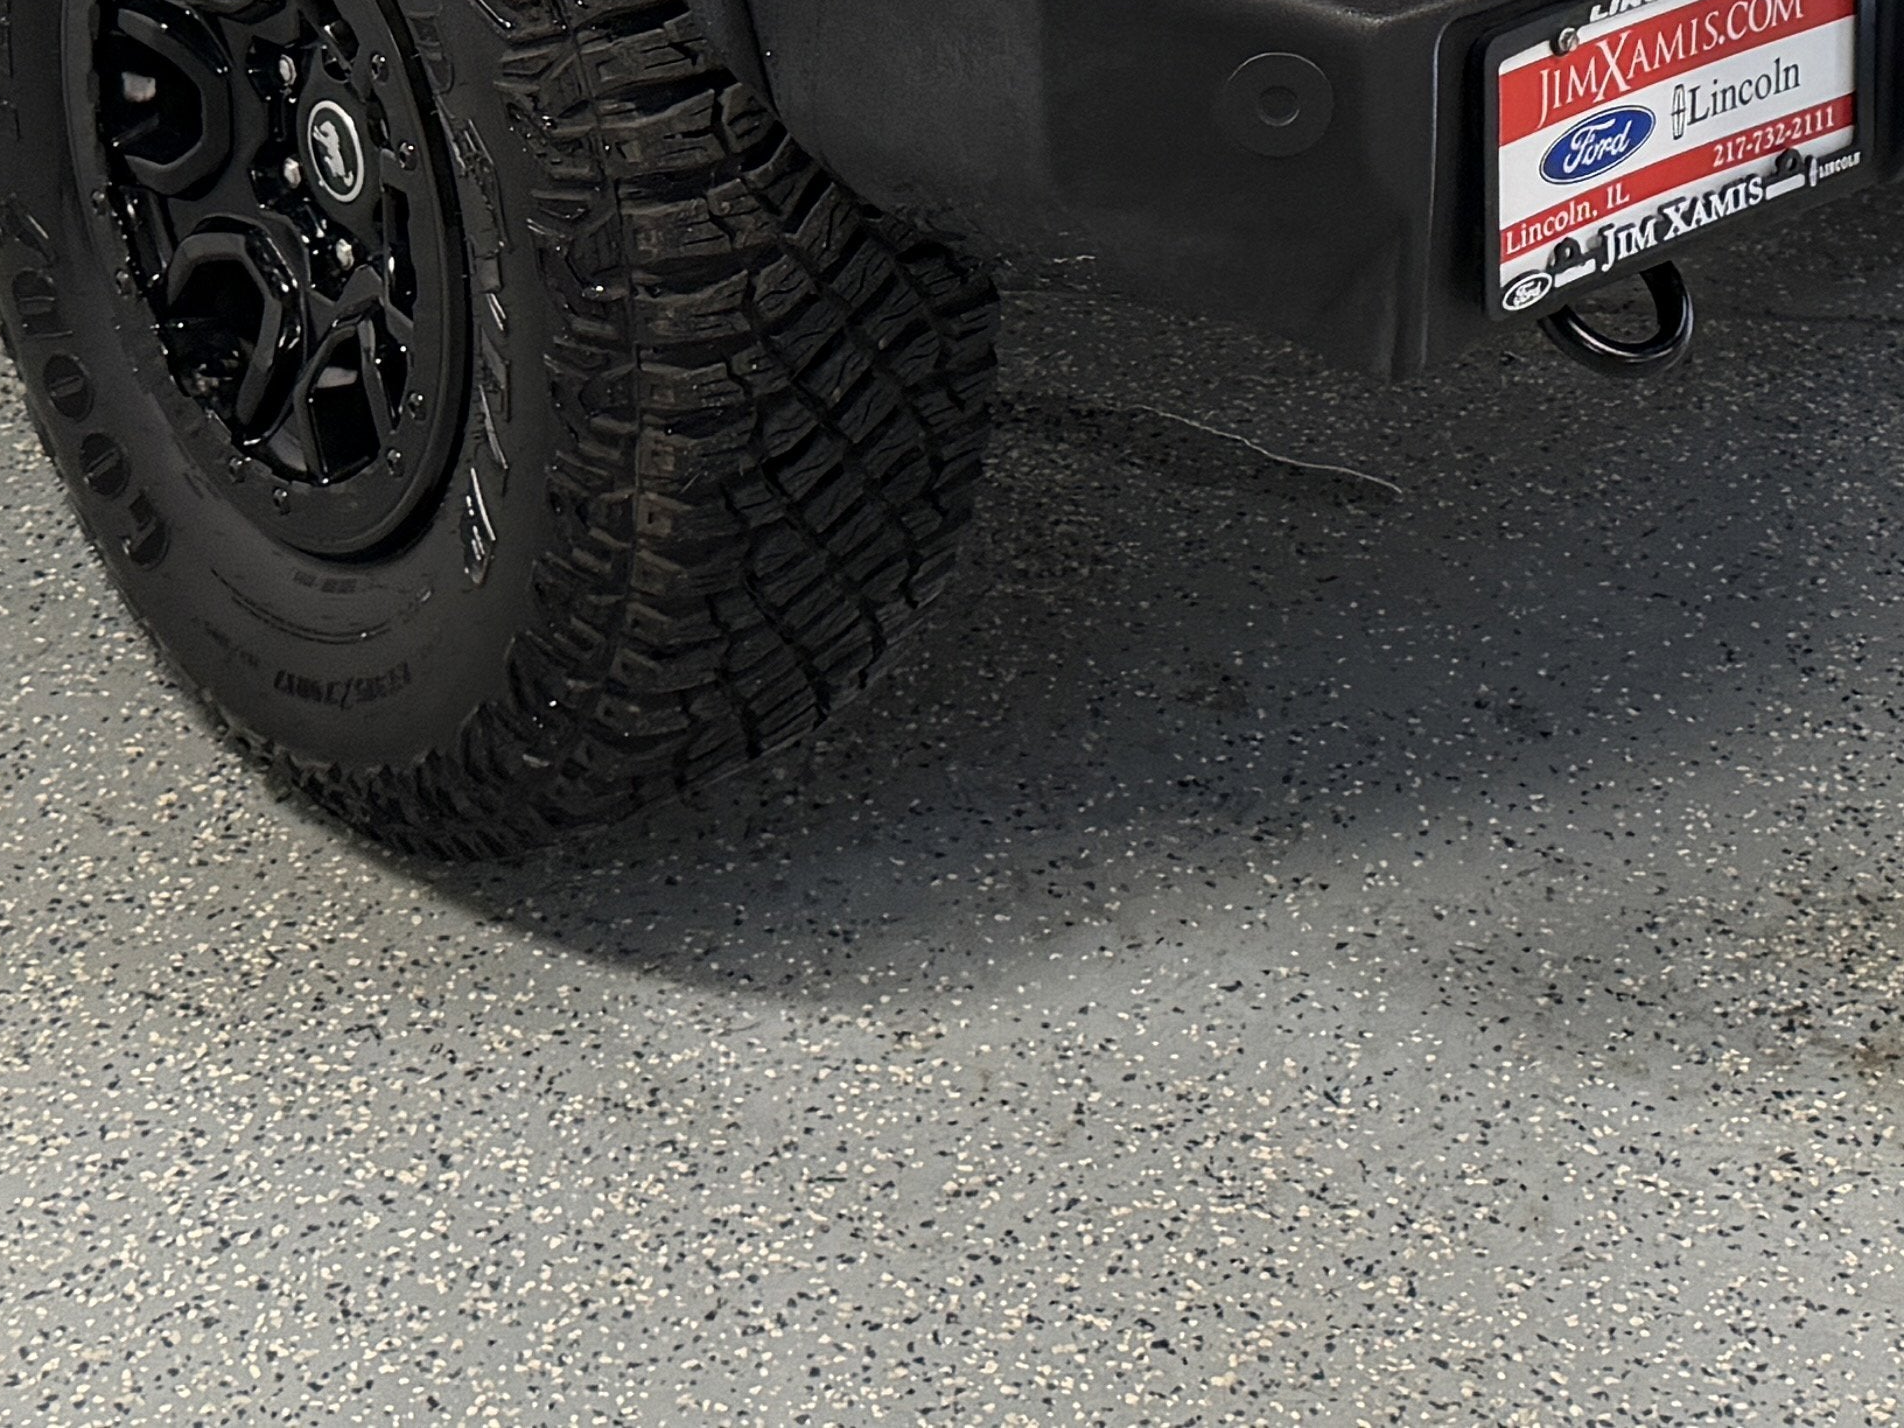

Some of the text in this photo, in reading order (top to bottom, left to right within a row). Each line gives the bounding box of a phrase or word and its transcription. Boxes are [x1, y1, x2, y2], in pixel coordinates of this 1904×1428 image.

[1687, 56, 1802, 127] Lincoln
[1712, 106, 1836, 168] 217-732-2111
[1506, 185, 1631, 256] Lincoln, IL
[1601, 177, 1766, 272] JIM XAMIS
